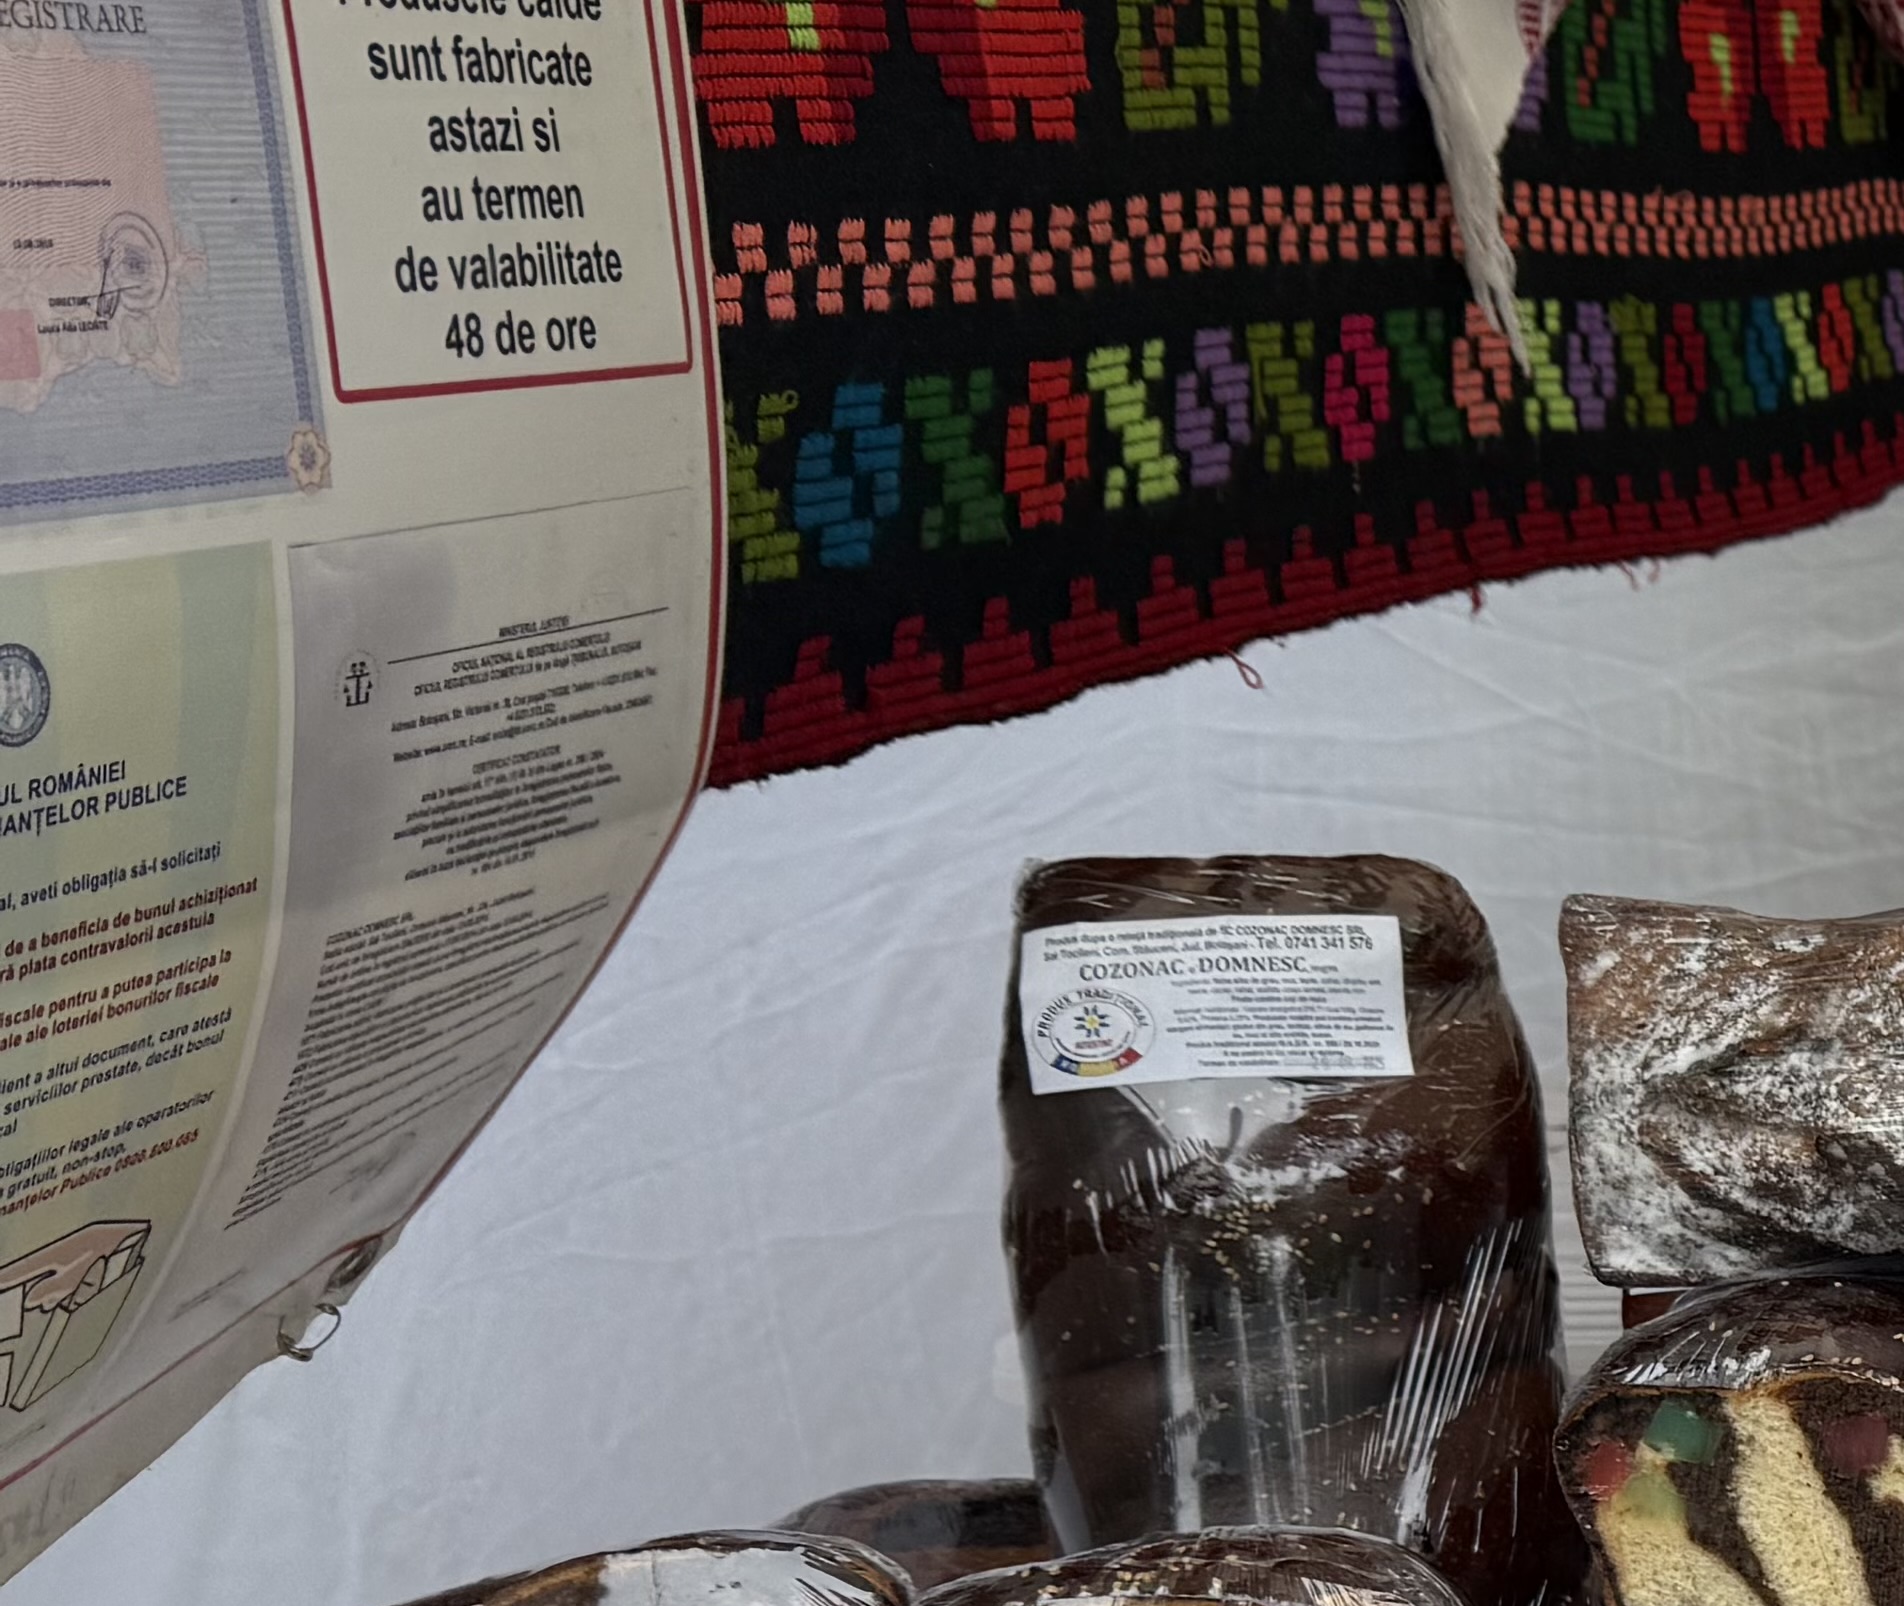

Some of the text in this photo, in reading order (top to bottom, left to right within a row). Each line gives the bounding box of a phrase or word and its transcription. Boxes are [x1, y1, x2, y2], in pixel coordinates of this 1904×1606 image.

[0, 0, 147, 33] EGISTRARE
[368, 34, 592, 87] sunt fabricate
[428, 106, 560, 152] astazi si
[421, 176, 584, 222] au termen
[395, 240, 622, 293] de valabilitate
[445, 309, 597, 358] 48 de ore
[28, 760, 126, 801] ROMÂNIEI
[105, 776, 187, 813] PUBLICE
[134, 897, 175, 918] bunul
[1285, 936, 1318, 950] 0741
[1322, 936, 1345, 950] 341
[19, 954, 56, 981] plata
[1079, 956, 1307, 981] COZONAC DOMNESC
